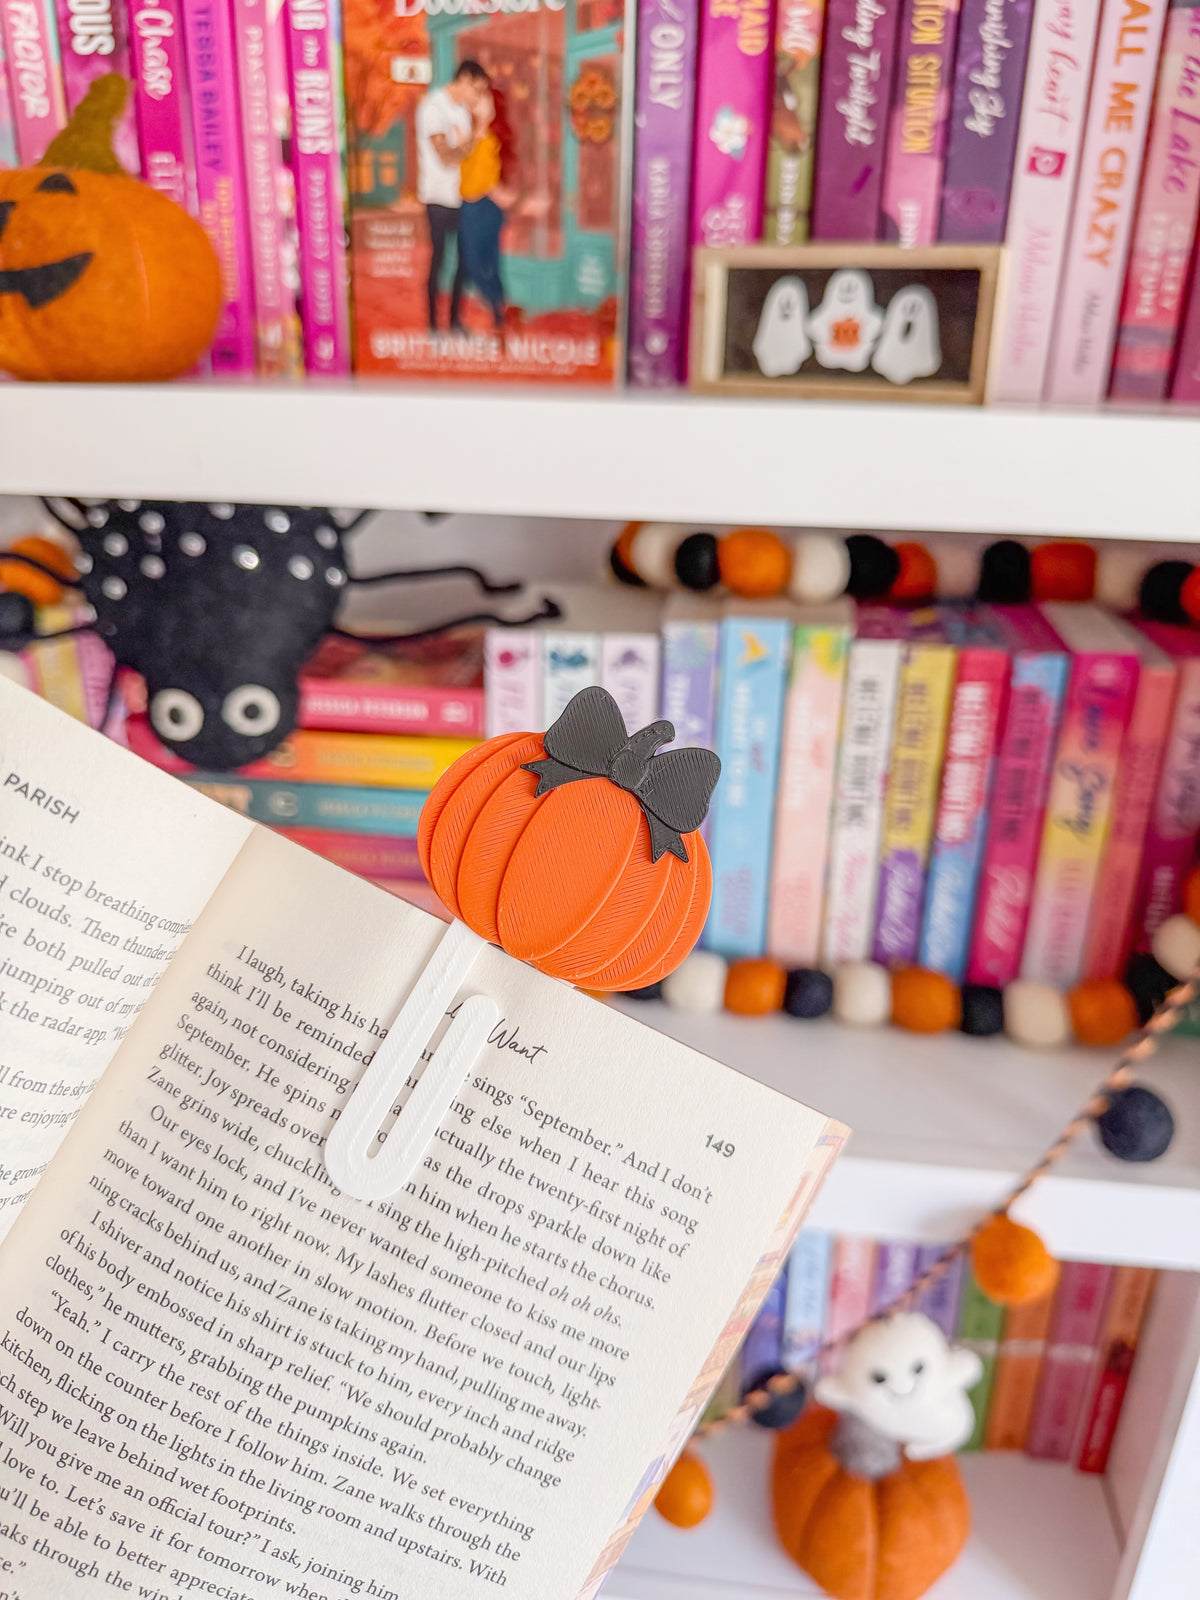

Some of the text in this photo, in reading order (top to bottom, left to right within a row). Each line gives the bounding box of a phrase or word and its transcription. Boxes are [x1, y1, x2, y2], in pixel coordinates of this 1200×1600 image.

[294, 69, 333, 155] REINS
[649, 23, 686, 111] ONLY
[902, 52, 943, 154] SITUATION
[1104, 81, 1138, 134] ME
[1084, 147, 1128, 270] CRAZY
[2, 772, 80, 824] PARISH
[29, 854, 43, 872] I
[42, 865, 83, 896] stop
[84, 880, 159, 931] breathing
[80, 917, 120, 946] Then
[236, 944, 248, 960] I
[244, 949, 286, 989] laugh,
[290, 978, 341, 1019] taking
[339, 1002, 367, 1029] his
[471, 1076, 514, 1107] sings
[621, 1151, 660, 1178] And
[659, 1167, 671, 1183] I
[671, 1174, 713, 1204] don't
[486, 1017, 548, 1064] Want
[176, 1013, 671, 1283] September. He spins as the drops sparkle down like
[191, 991, 228, 1025] again,
[230, 1017, 259, 1039] not
[258, 1034, 352, 1095] considering
[497, 1157, 524, 1180] the
[527, 1172, 621, 1227] twenty-first
[622, 1221, 666, 1248] night
[668, 1242, 690, 1258] of
[206, 963, 244, 995] think
[245, 985, 271, 1010] I'll
[272, 999, 292, 1023] be
[295, 1019, 377, 1068] reminded
[480, 1114, 512, 1139] else
[519, 1134, 561, 1165] when
[567, 1155, 579, 1172] I
[581, 1161, 620, 1192] hear
[624, 1185, 655, 1209] this
[660, 1206, 699, 1235] song
[705, 1133, 735, 1158] 149
[146, 1065, 182, 1099] Zane
[178, 1094, 220, 1124] grins
[221, 1117, 260, 1152] wide,
[377, 1202, 413, 1232] sing
[414, 1219, 441, 1243] the
[443, 1231, 549, 1292] high-pitched
[548, 1285, 569, 1302] oh
[571, 1295, 591, 1312] oh
[593, 1305, 621, 1327] ohs.
[158, 1043, 654, 1309] glitter. Joy spreads over him when he starts the chorus.
[90, 1209, 575, 1463] I shiver and notice his shirt is stuck to him, every inch and ridge
[16, 1388, 296, 1535] step we leave behind wet footprints.
